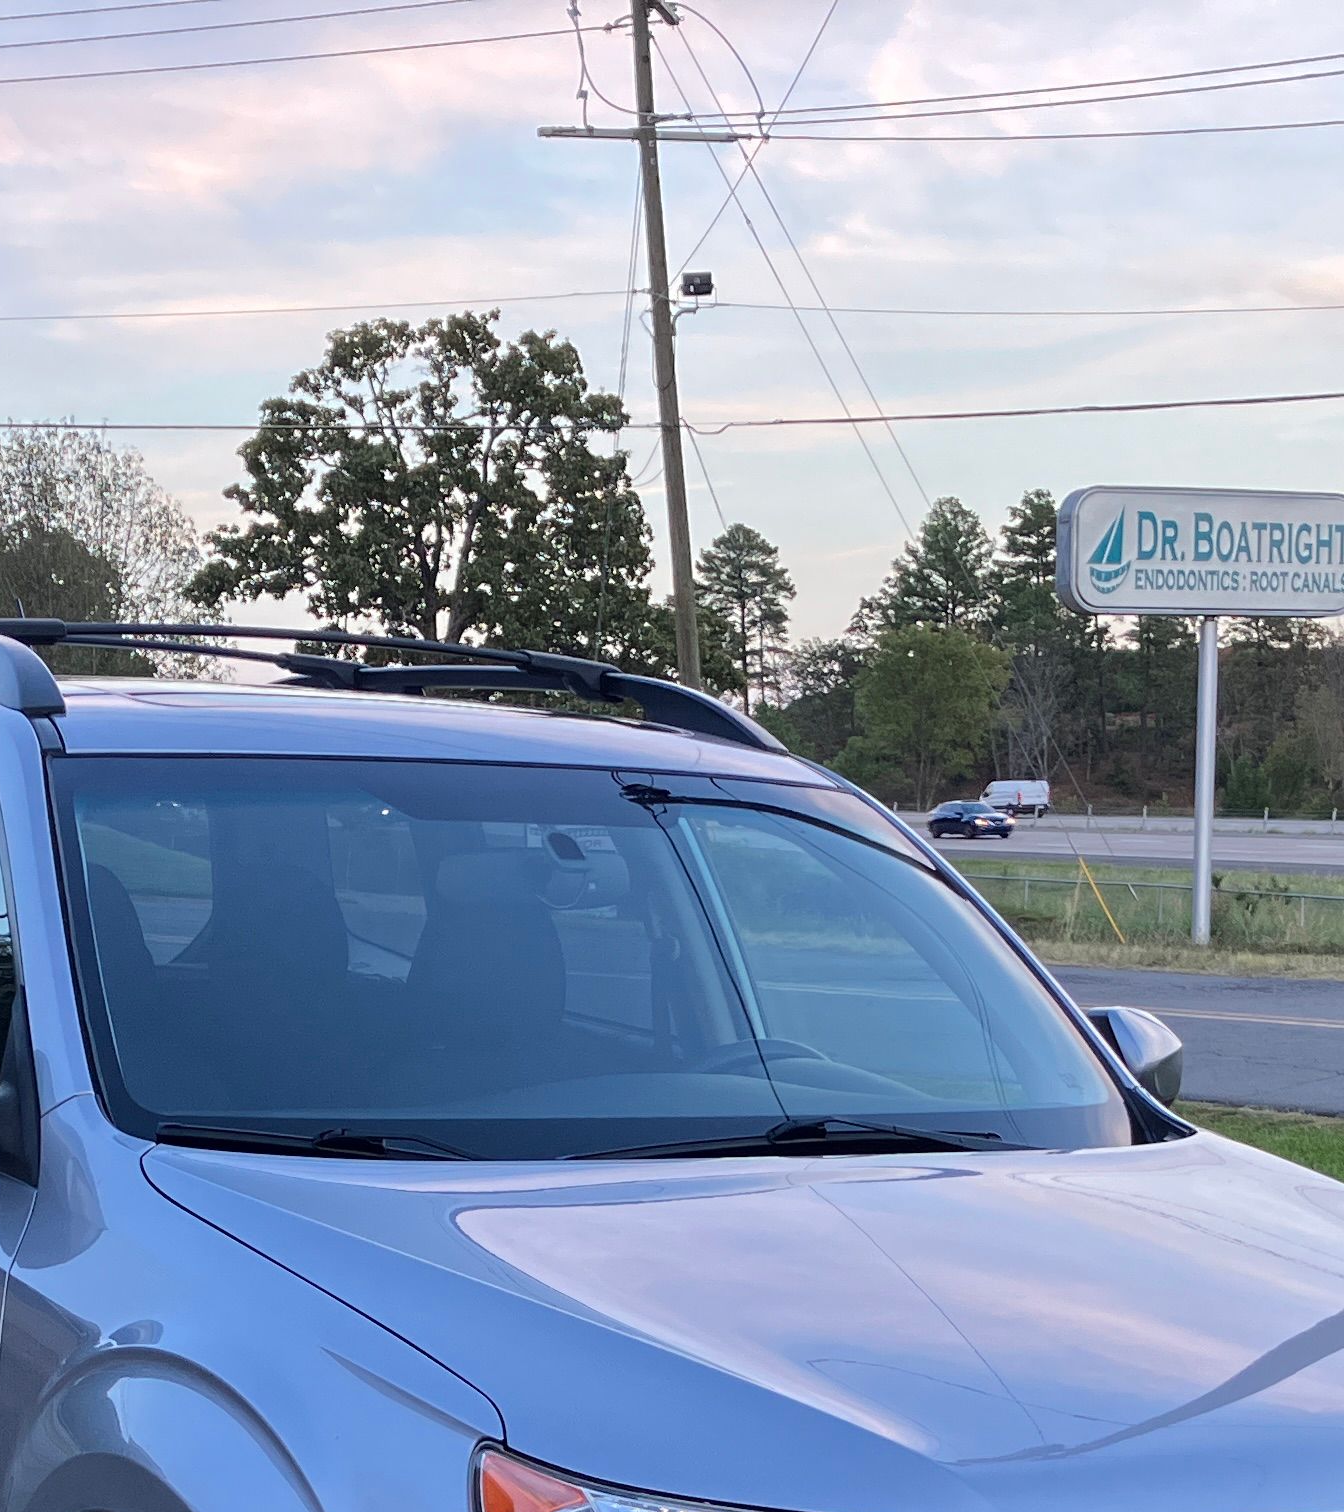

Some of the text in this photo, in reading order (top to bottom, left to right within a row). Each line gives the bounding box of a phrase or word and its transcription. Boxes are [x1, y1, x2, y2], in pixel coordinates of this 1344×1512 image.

[1136, 511, 1185, 562] DR.
[1135, 569, 1240, 592] ENDODONTICS
[1250, 571, 1289, 593] ROOT
